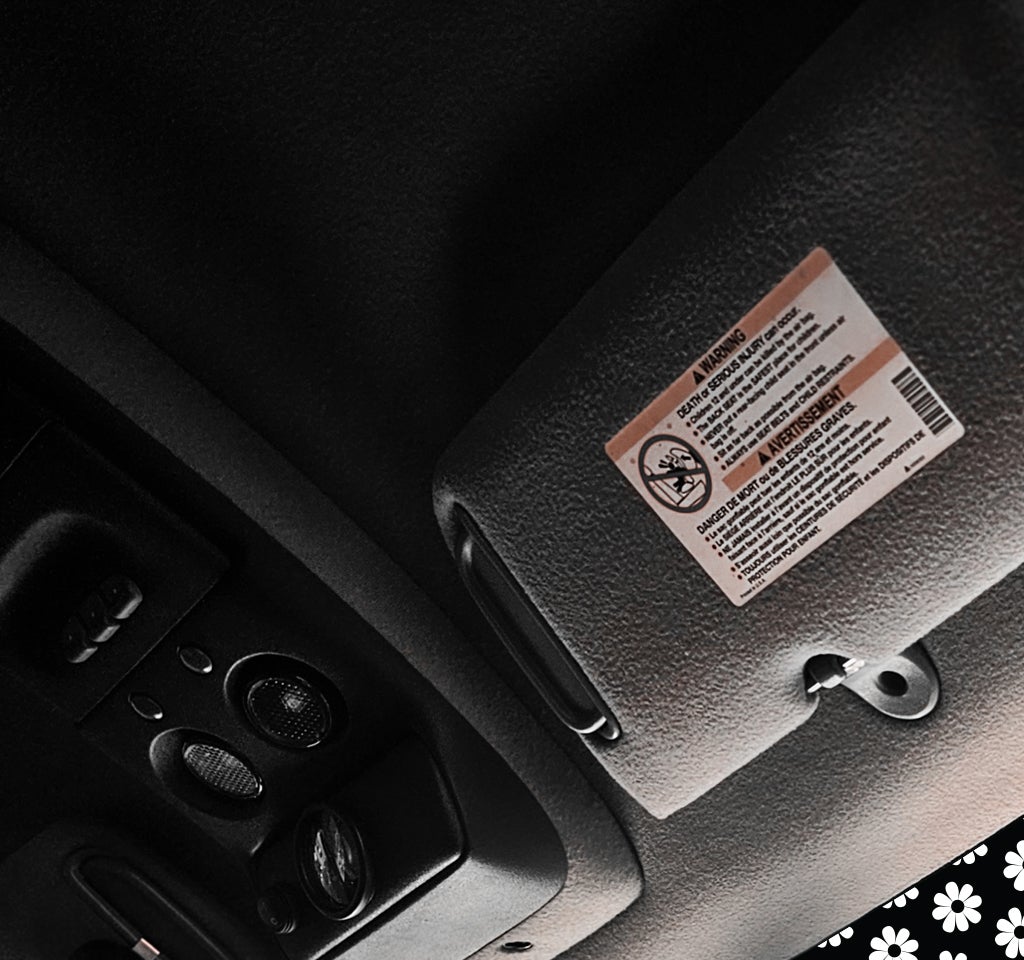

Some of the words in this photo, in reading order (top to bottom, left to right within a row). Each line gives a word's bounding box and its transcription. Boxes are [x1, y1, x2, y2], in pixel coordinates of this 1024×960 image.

[676, 393, 703, 419] DEATH
[700, 387, 710, 399] or
[707, 359, 741, 392] SERIOUS
[737, 335, 765, 364] INJURY
[777, 306, 801, 329] occur.
[698, 328, 747, 374] WARNING
[706, 407, 725, 425] BACK
[722, 394, 738, 411] SEAT
[711, 396, 720, 405] 12
[756, 424, 772, 441] SEAT
[798, 385, 818, 404] CHILD
[767, 384, 846, 457] AVERTISSEMENT
[703, 422, 724, 442] NEVER
[696, 505, 730, 535] DANGER
[736, 479, 760, 502] MORT
[758, 473, 771, 485] ou
[776, 428, 823, 469] BLESSURES
[820, 401, 857, 433] GRAVES.
[806, 449, 817, 459] 12
[740, 550, 772, 577] TOUJOURS
[747, 555, 784, 585] PROTECTION
[781, 542, 799, 558] POUR
